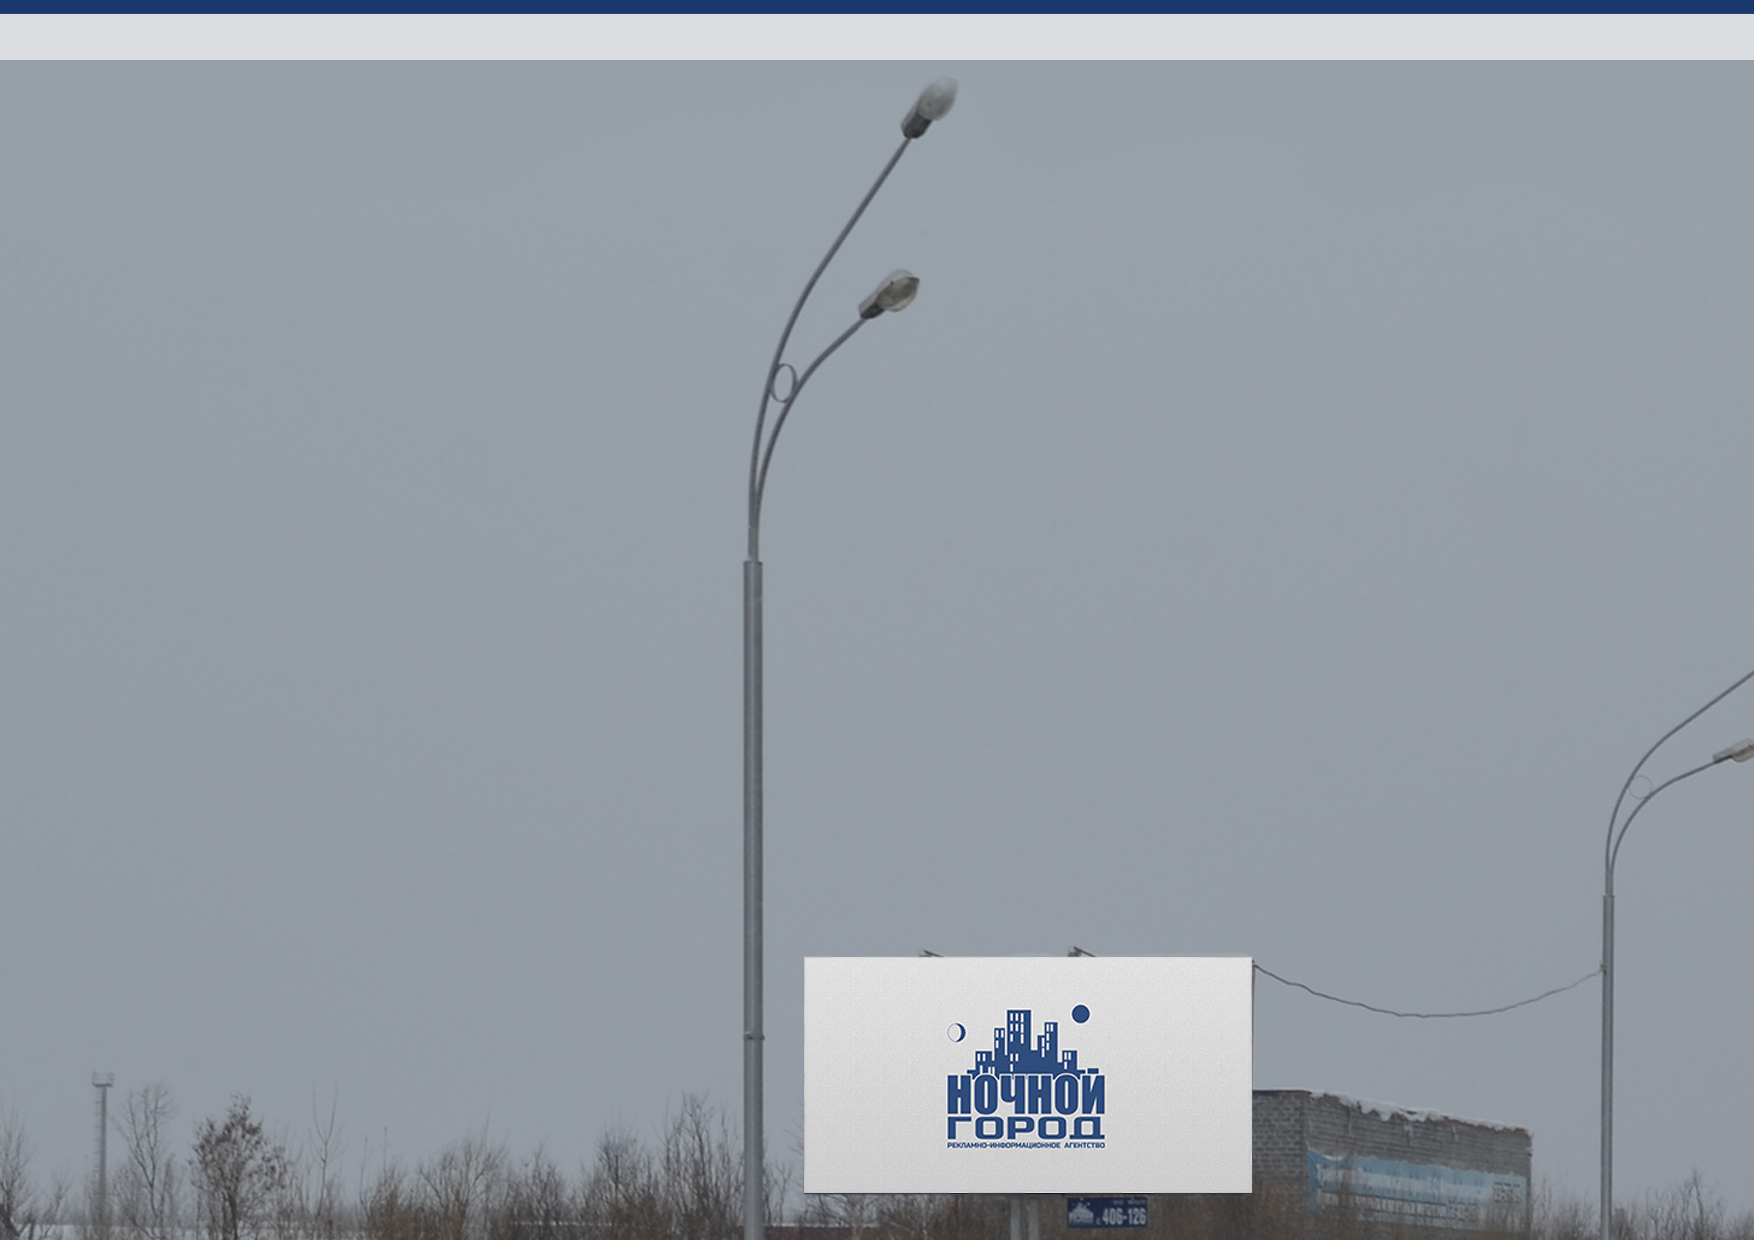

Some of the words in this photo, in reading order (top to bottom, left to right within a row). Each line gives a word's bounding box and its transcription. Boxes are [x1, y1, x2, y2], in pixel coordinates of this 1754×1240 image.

[947, 1068, 1105, 1115] НОЧНОЙ
[947, 1116, 1105, 1140] ГОРОД
[1102, 1207, 1147, 1226] 406-126
